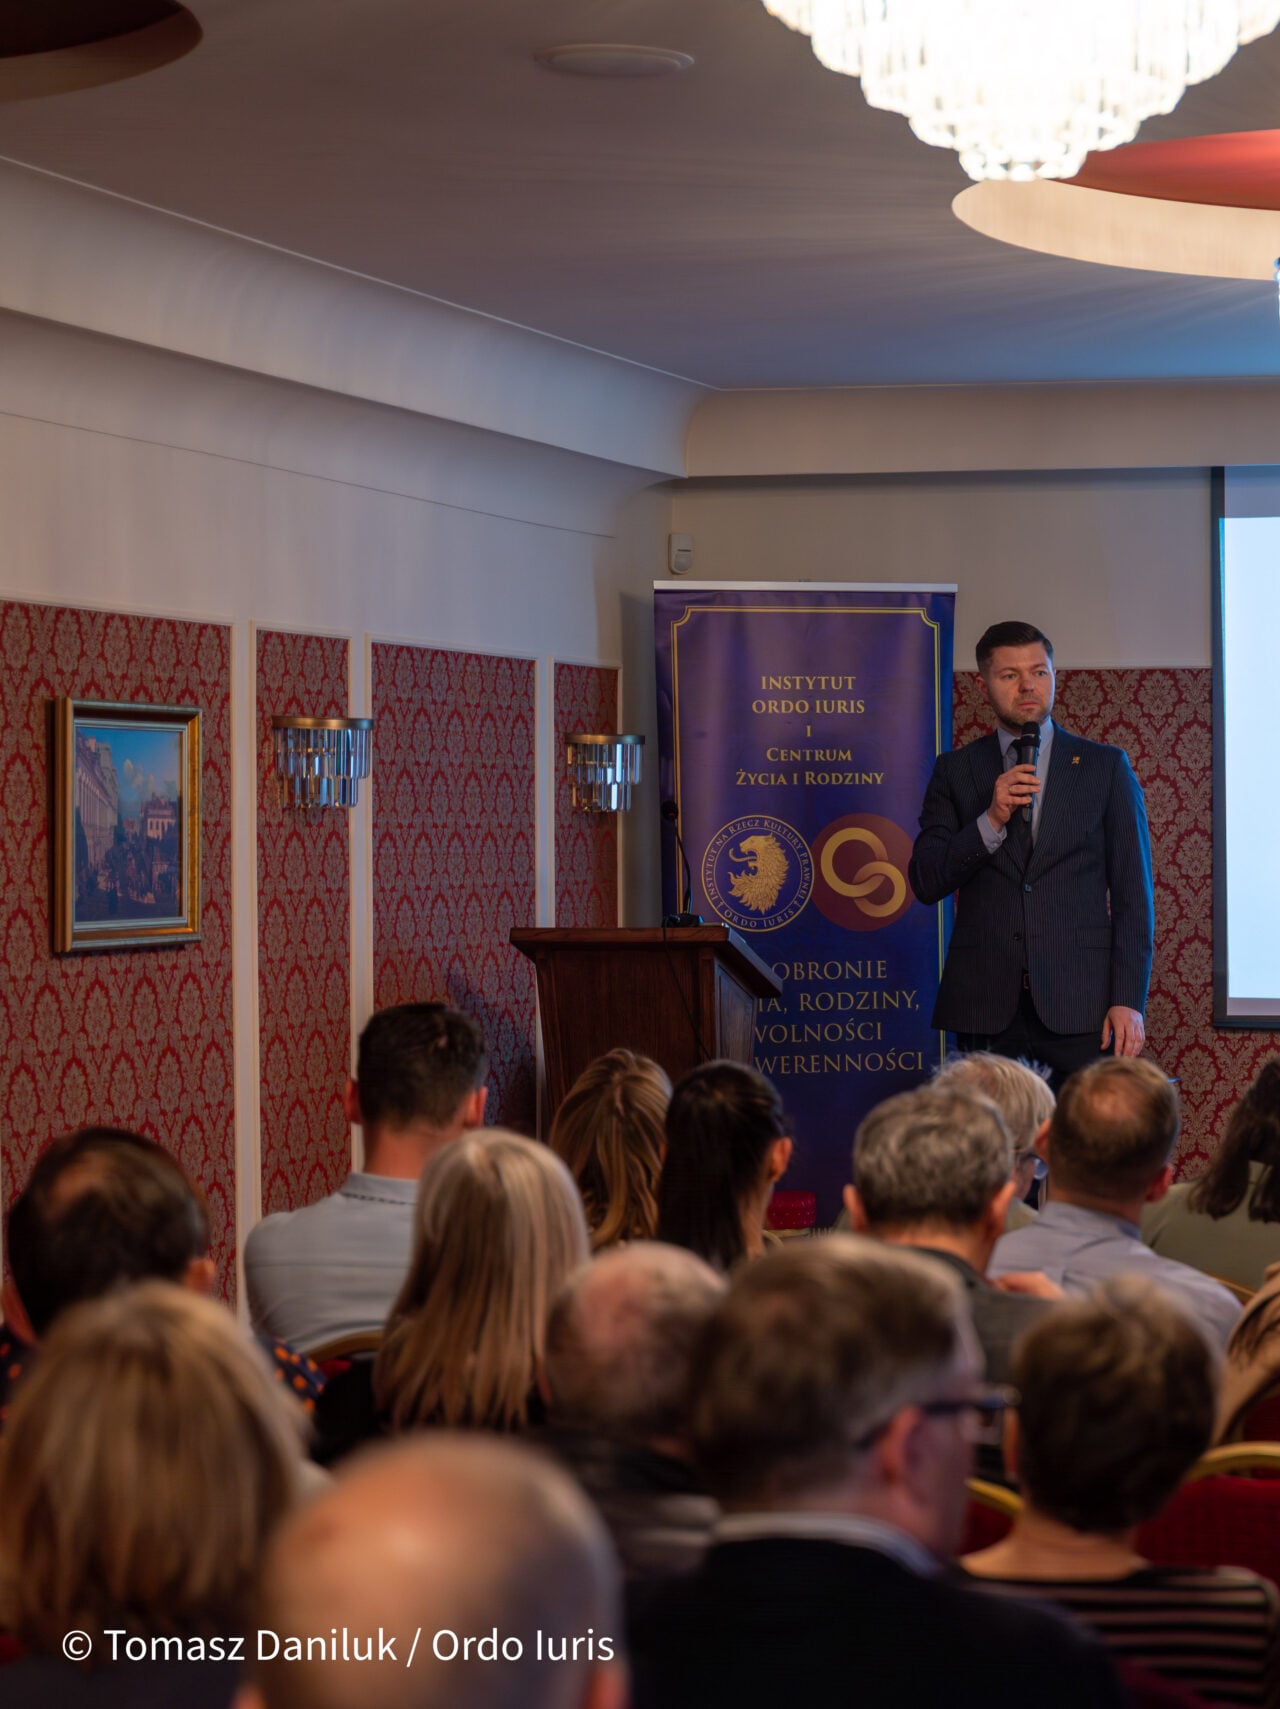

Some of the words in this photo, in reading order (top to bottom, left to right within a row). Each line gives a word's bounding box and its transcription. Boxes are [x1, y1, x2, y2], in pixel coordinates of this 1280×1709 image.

[760, 676, 856, 690] INSTYTUT
[751, 700, 810, 714] ORDO
[815, 700, 865, 714] IURIS
[706, 848, 718, 900] INSTYTUT
[716, 834, 728, 847] NA
[728, 819, 760, 834] RZECZ
[763, 820, 803, 850] KULTURY
[724, 909, 757, 928] ORDO
[763, 909, 794, 927] IURIS
[772, 960, 887, 980] OBRONIE
[758, 997, 788, 1014] IA,
[800, 990, 920, 1011] RODZINY,
[754, 1048, 923, 1074] WERENNOŚCI
